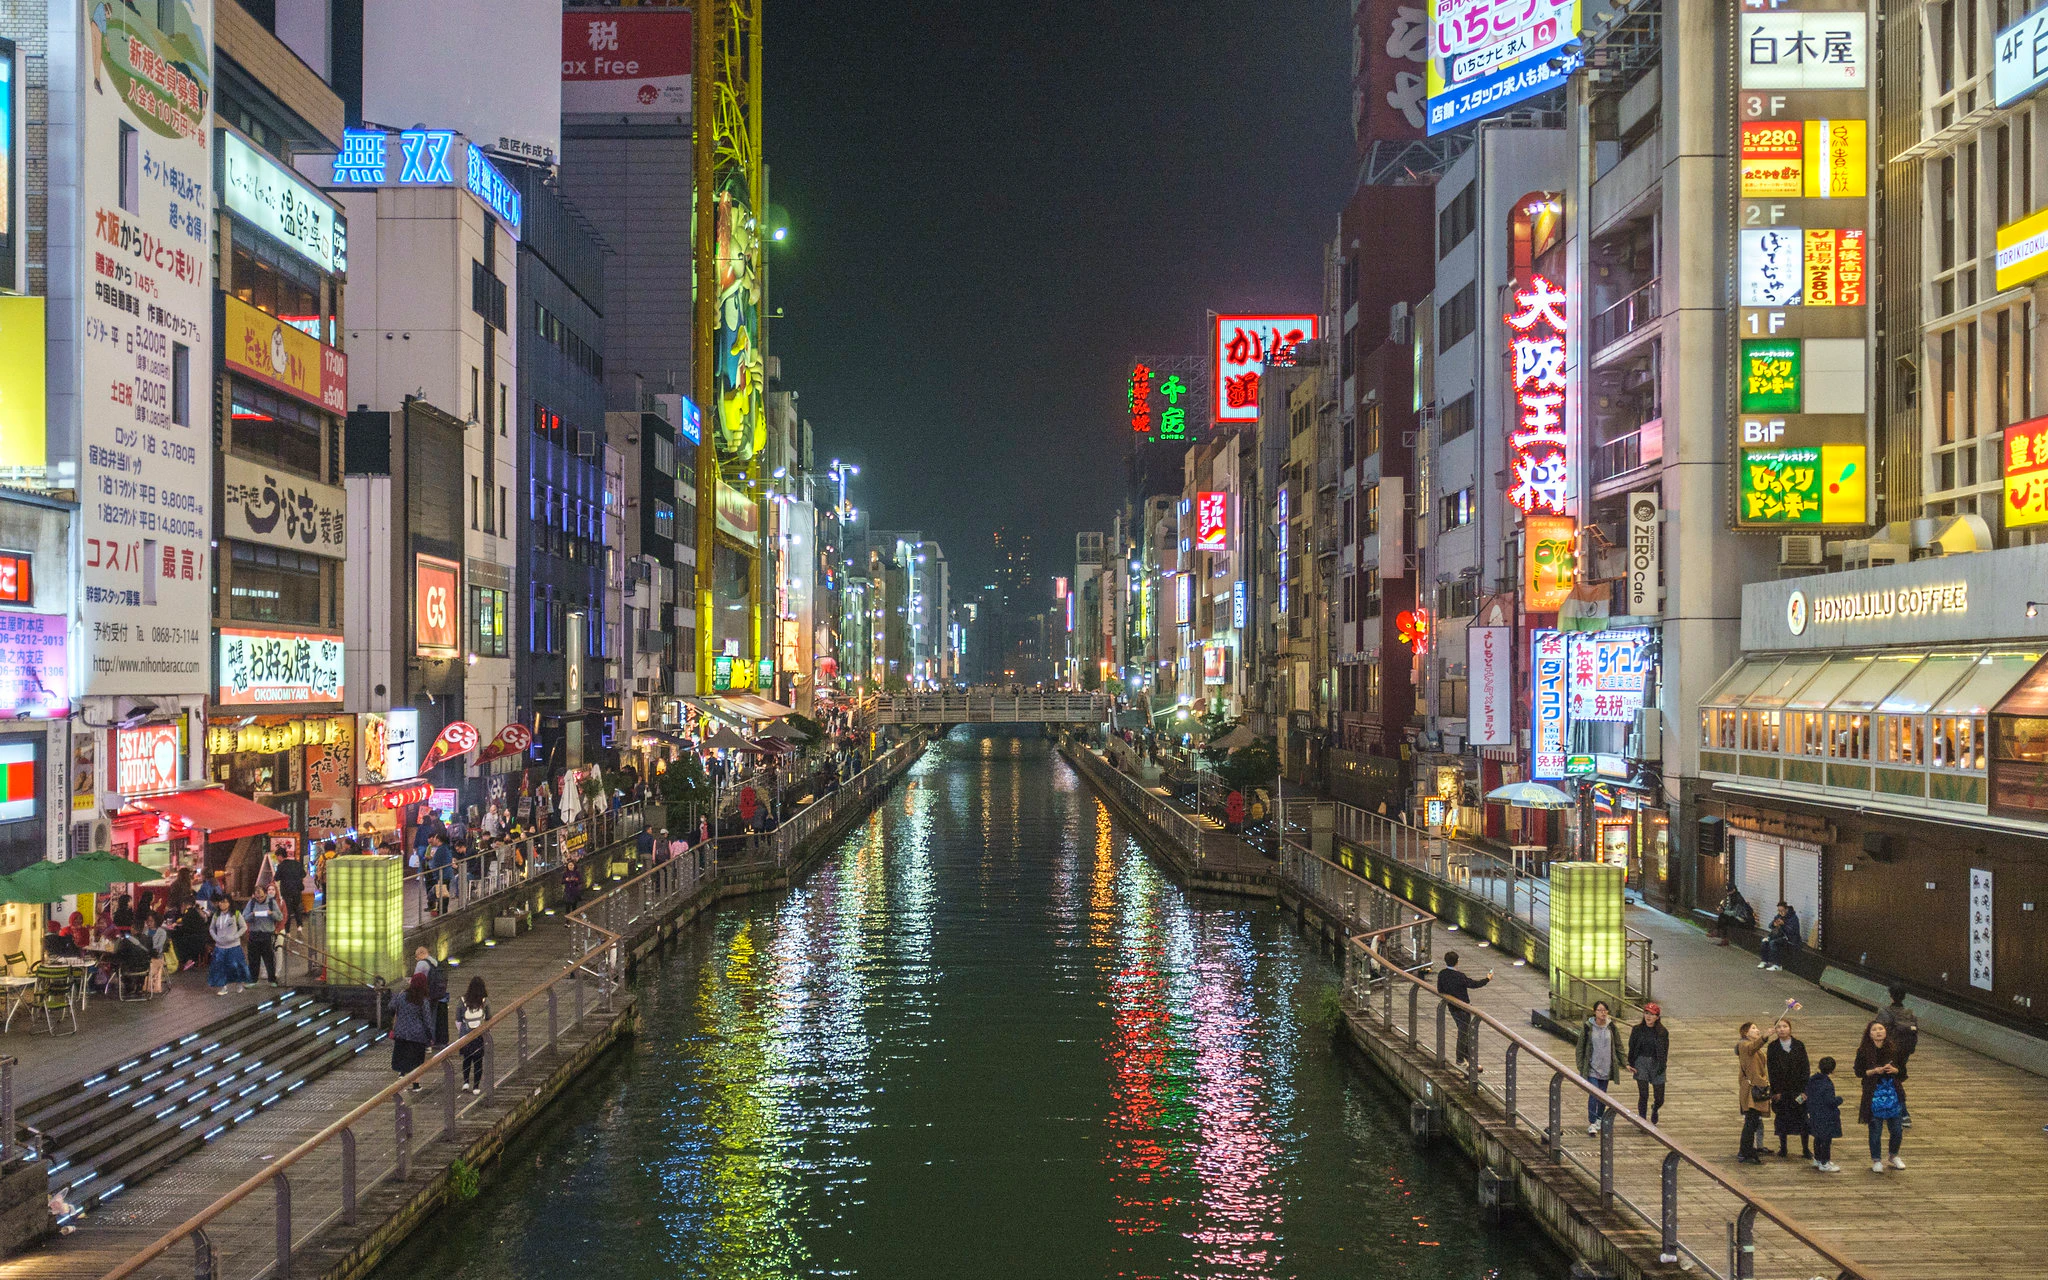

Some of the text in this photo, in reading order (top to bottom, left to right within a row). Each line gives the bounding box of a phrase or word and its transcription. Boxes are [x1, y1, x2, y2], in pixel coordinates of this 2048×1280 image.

[588, 21, 619, 51] 税
[1507, 36, 1527, 55] 求人
[1751, 26, 1855, 64] 白木屋
[2001, 29, 2024, 64] 4F
[562, 57, 639, 75] ax Free
[498, 137, 554, 159] 意匠作成中
[95, 207, 203, 288] 大阪からひとっ走り!
[1845, 230, 1863, 238] 2F
[1761, 231, 1788, 302] ぼてぢゅう
[1805, 240, 1833, 264] 酒場
[1998, 234, 2045, 270] TORIKIZOKU
[1812, 271, 1828, 300] 280
[1838, 238, 1862, 305] 豊後高田どり
[95, 280, 140, 318] 中国自動車道
[1788, 296, 1801, 305] 2F
[136, 325, 166, 358] 5,200円
[1225, 327, 1304, 367] かに
[325, 350, 345, 379] 17:00
[1751, 358, 1793, 378] びっくり
[110, 376, 166, 410] 土日祝 7,800円
[1505, 274, 1567, 516] 大阪王将
[1749, 376, 1795, 394] ドンキー
[1160, 375, 1187, 433] 千房
[115, 427, 195, 465] ロッジ 1泊 3,780円
[1744, 420, 1786, 443] B1F
[1747, 453, 1818, 461] ハンバーグレストラン
[1750, 464, 1815, 493] びっくり
[140, 484, 156, 504] 平日
[1747, 491, 1818, 518] ドンキー
[140, 511, 156, 531] 平日
[244, 474, 318, 545] うなぎ
[319, 507, 344, 545] 菱富
[1199, 500, 1211, 536] ドラッグ
[1211, 494, 1225, 528] ツルハ
[87, 538, 203, 581] コスパ 最高!
[1634, 525, 1650, 570] ZERO
[86, 585, 141, 607] 幹部スタッフ募集
[427, 586, 446, 629] G3
[1814, 582, 1968, 624] HONOLULU COFFEE
[93, 622, 128, 643] 予約受付
[151, 626, 199, 645] 0868-75-1144
[1541, 632, 1562, 655] 薬
[93, 654, 200, 677] http://www.nihonbaracc.com
[250, 638, 311, 684] お好み焼
[1576, 643, 1594, 687] 薬
[1598, 646, 1643, 673] ダイコク
[254, 687, 309, 701] OKONOMIYAKI
[1483, 630, 1496, 741] よしもとエンタメショップ
[1541, 660, 1562, 720] ダイコク
[1594, 694, 1623, 717] 免税
[119, 731, 153, 760] 5STAR
[444, 725, 474, 749] G3
[502, 725, 528, 750] G3
[119, 758, 156, 789] HOTDOG
[1538, 755, 1565, 767] 免税
